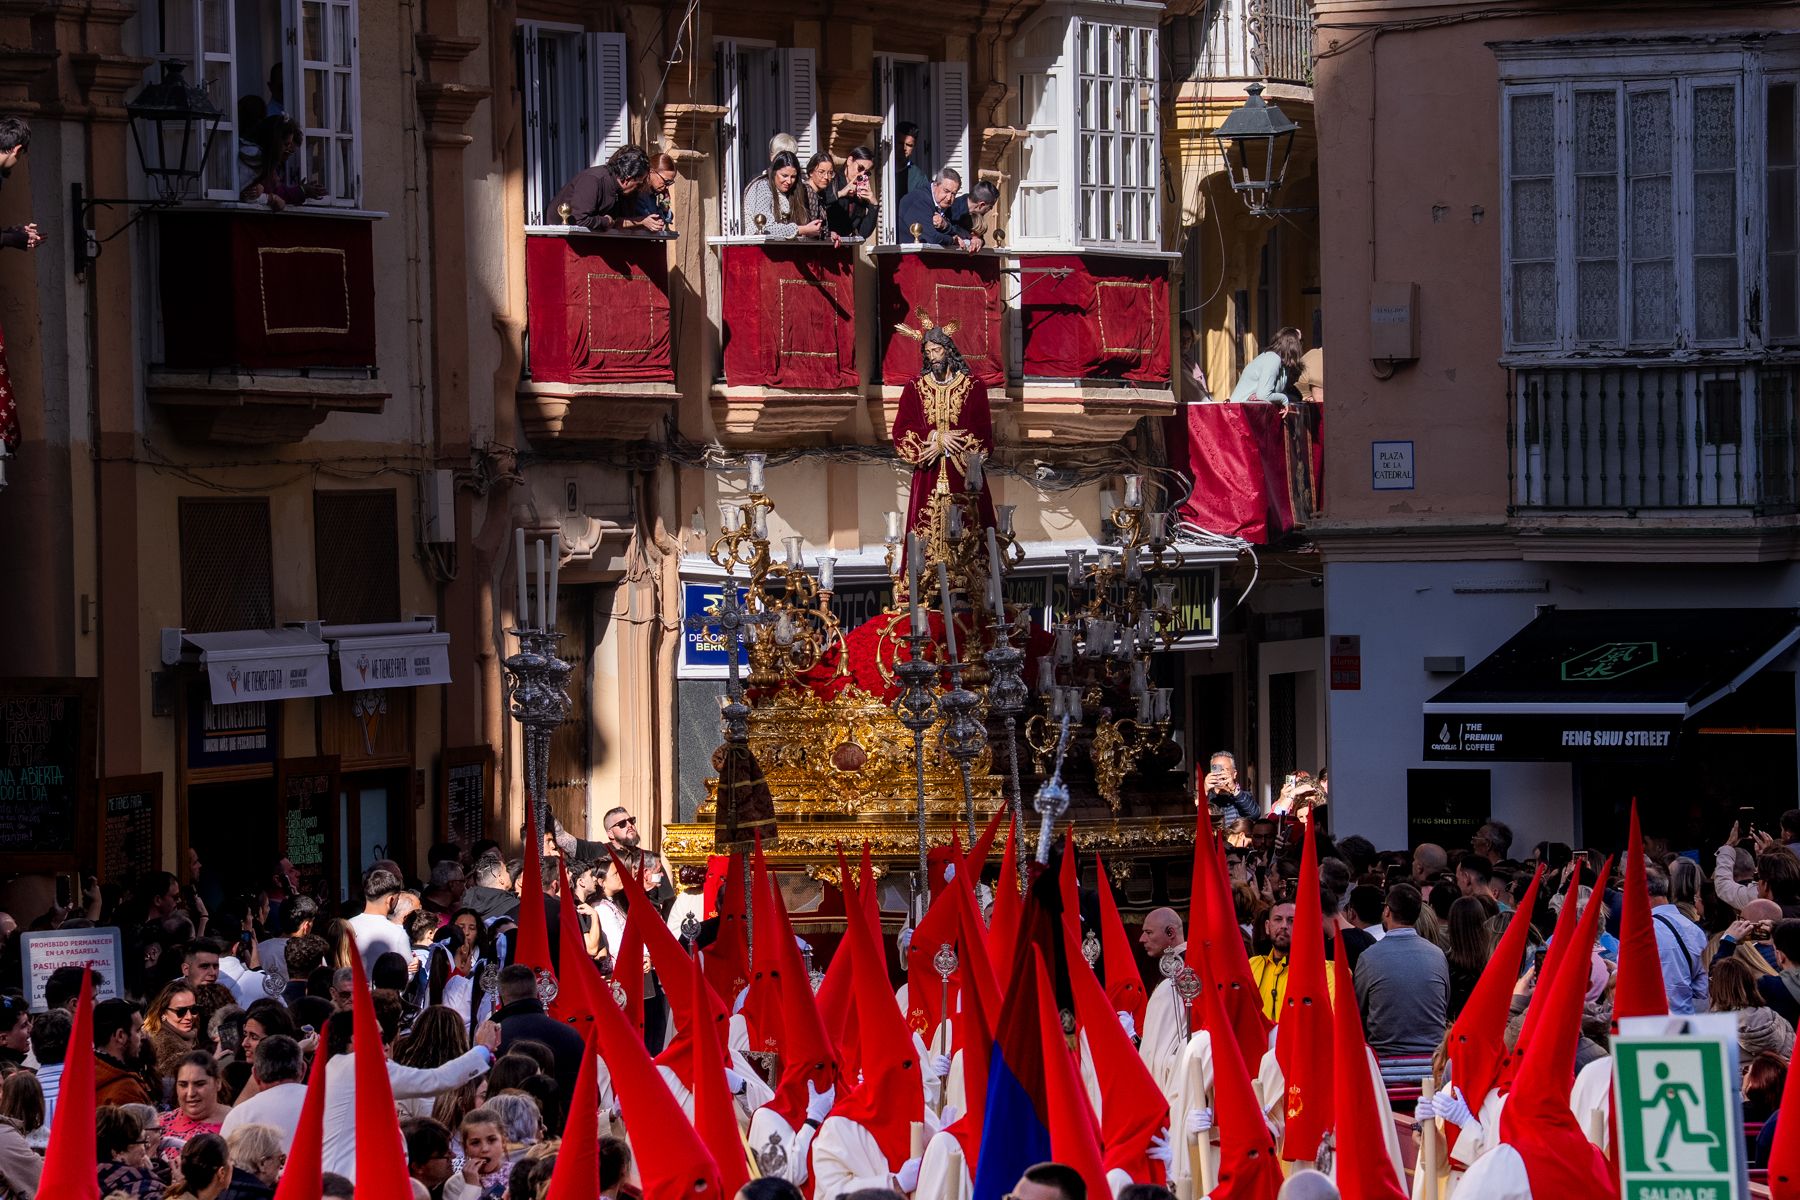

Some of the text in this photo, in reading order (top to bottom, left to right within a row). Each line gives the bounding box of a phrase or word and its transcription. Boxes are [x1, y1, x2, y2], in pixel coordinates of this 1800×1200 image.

[1380, 451, 1404, 460] PLAZA
[1374, 470, 1412, 479] CATEDRAL
[243, 671, 250, 692] ME
[251, 670, 267, 691] TIENES
[1465, 723, 1483, 731] THE
[1464, 733, 1503, 742] PREMIUM
[1562, 730, 1671, 747] FENG SHUI STREET
[1465, 743, 1495, 751] COFFEE
[30, 938, 112, 949] PROHIBIDO PERMANECER
[33, 961, 67, 970] PASILLO
[1639, 1187, 1717, 1200] SALIDA DE
